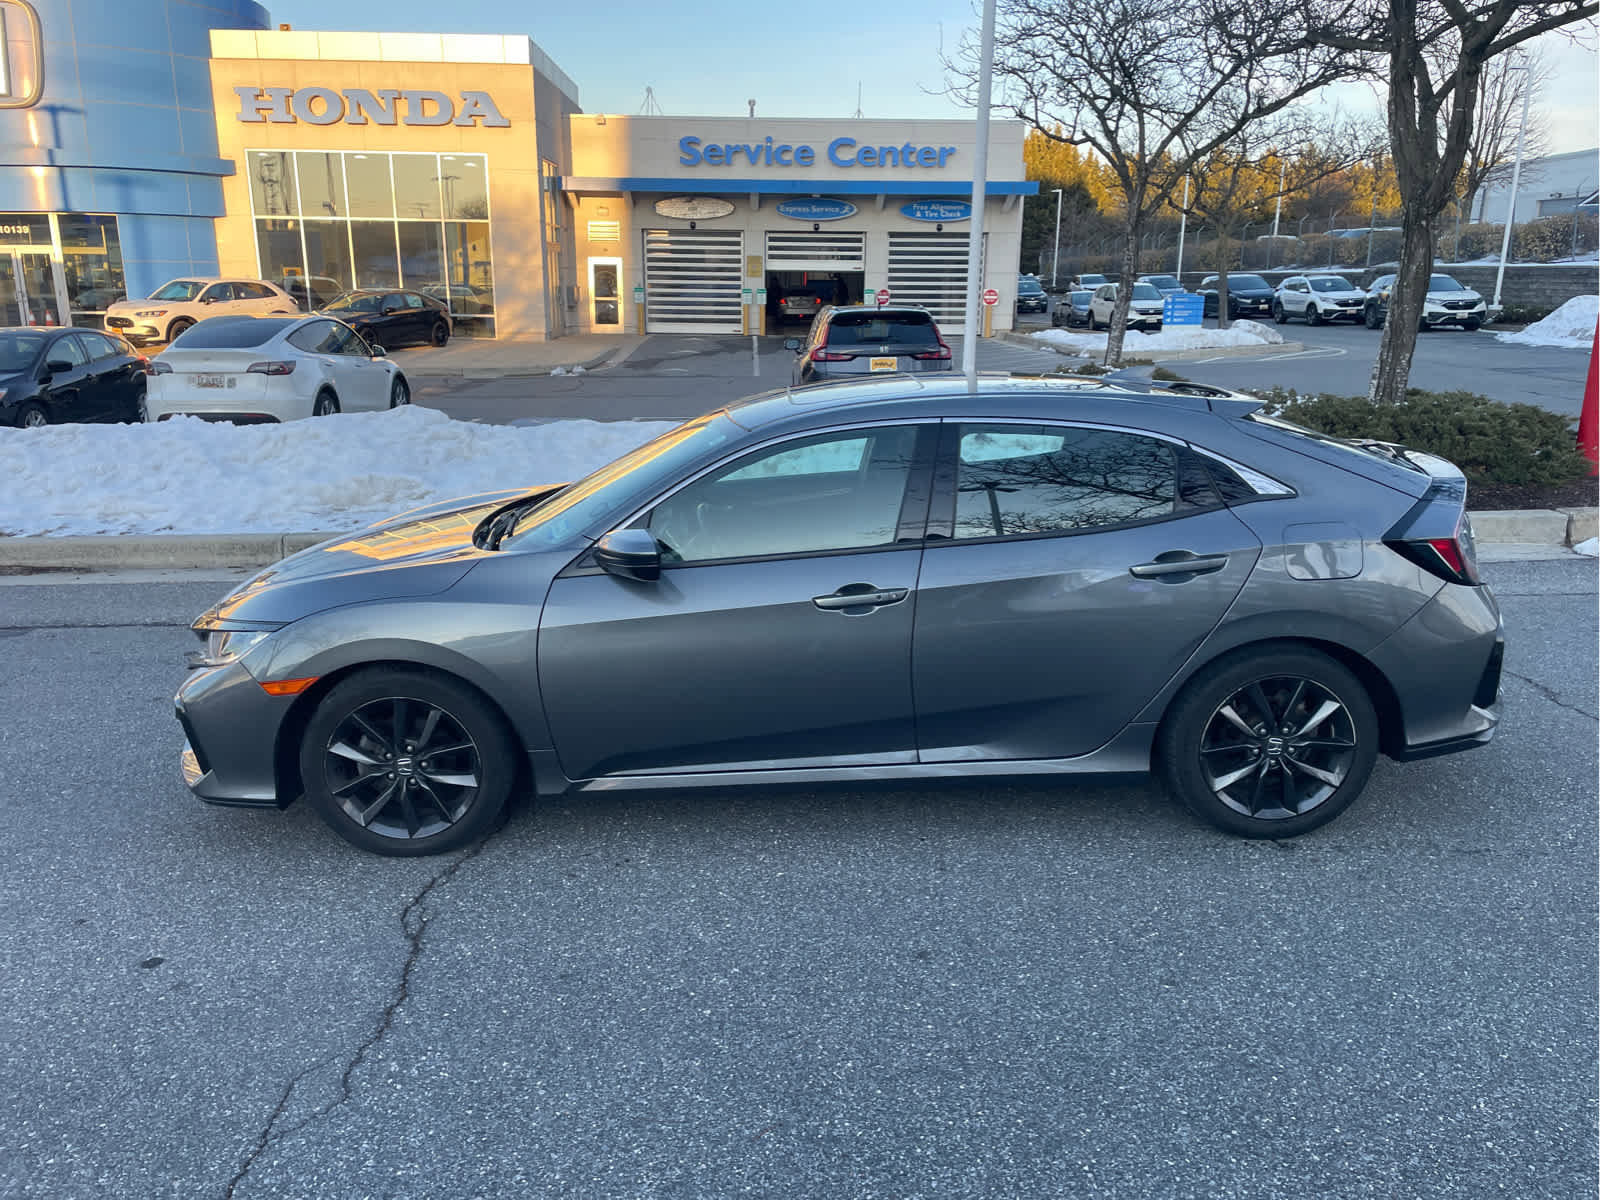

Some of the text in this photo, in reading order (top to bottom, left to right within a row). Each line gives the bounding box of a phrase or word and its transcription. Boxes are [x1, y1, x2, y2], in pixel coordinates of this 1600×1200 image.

[233, 86, 511, 127] HONDA
[679, 135, 957, 168] Service Center
[779, 204, 841, 214] Express Service
[912, 203, 966, 213] Free Alignment
